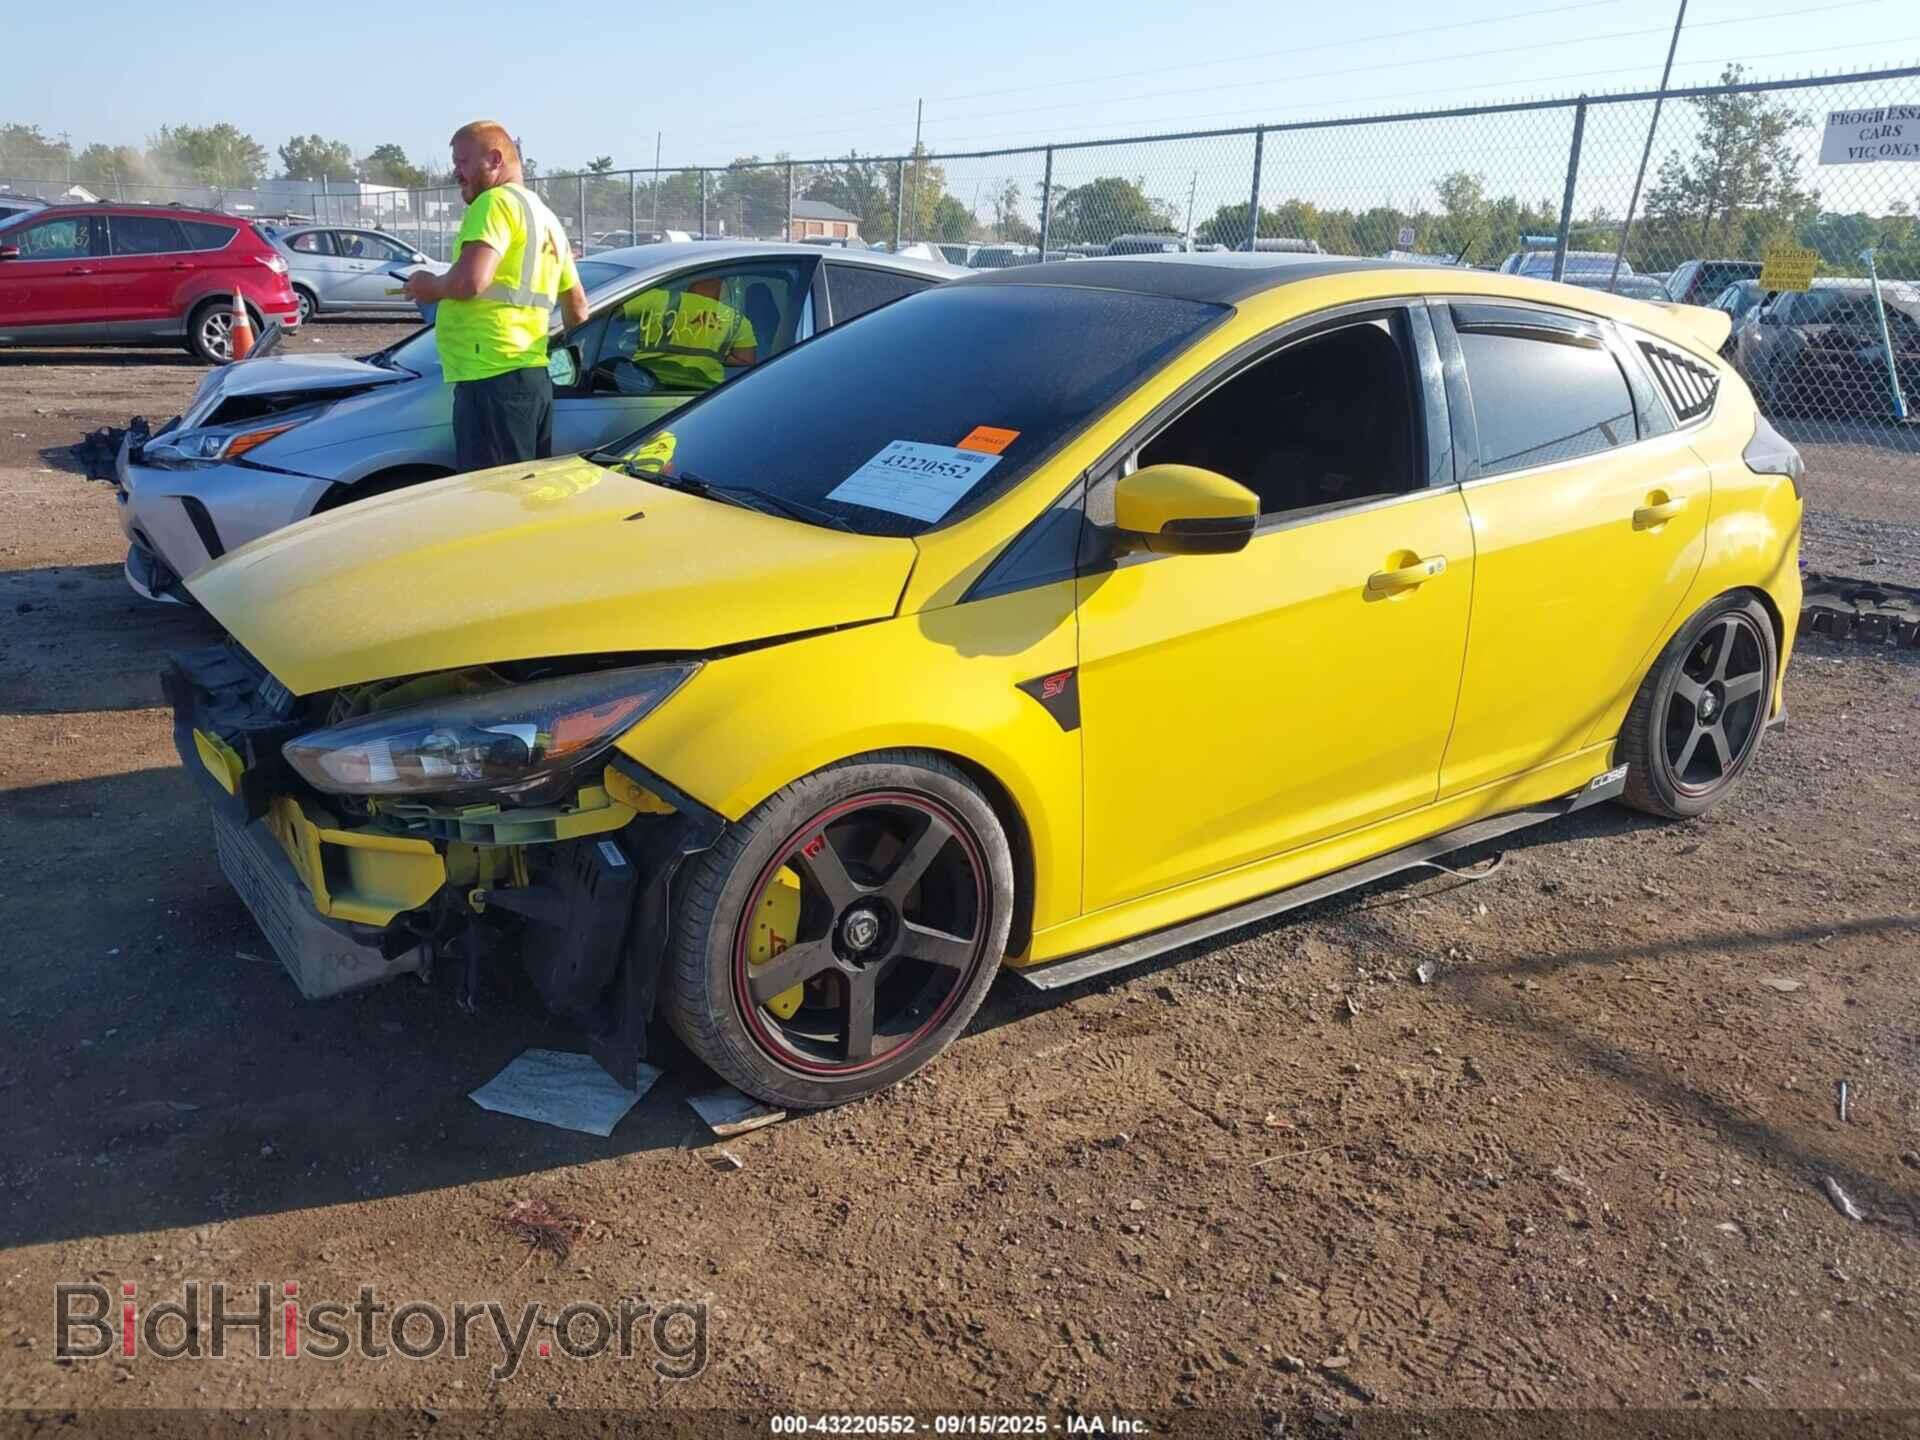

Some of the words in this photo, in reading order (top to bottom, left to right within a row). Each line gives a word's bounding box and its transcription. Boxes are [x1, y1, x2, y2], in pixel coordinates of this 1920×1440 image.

[1830, 107, 1920, 126] PROGRESS
[1859, 124, 1903, 141] CARS
[1848, 146, 1876, 159] VIC
[881, 453, 972, 479] 43220552
[1041, 671, 1072, 699] ST
